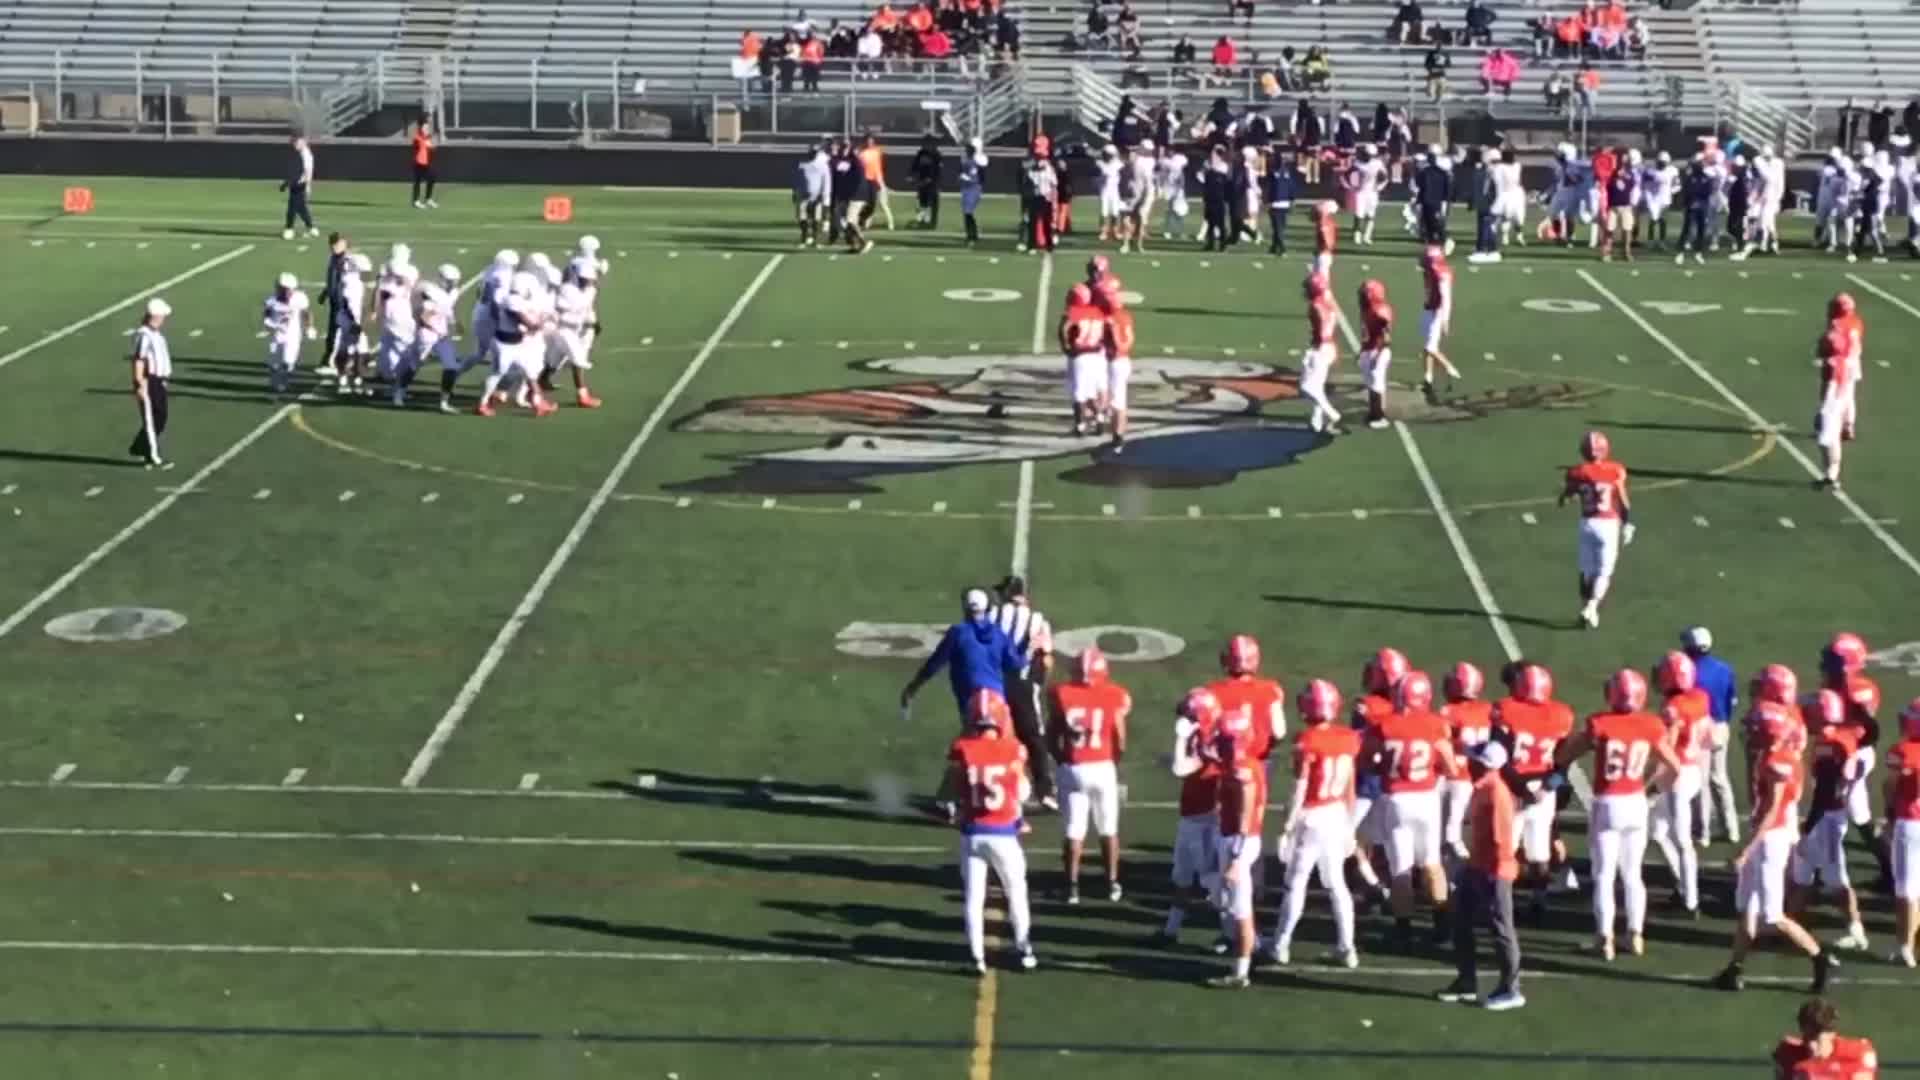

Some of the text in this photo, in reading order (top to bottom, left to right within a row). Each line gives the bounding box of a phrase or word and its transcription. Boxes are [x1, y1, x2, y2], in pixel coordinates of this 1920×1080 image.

[1066, 707, 1104, 749] 51
[1384, 740, 1431, 782] 72
[1604, 739, 1650, 782] 60
[966, 764, 1006, 811] 15
